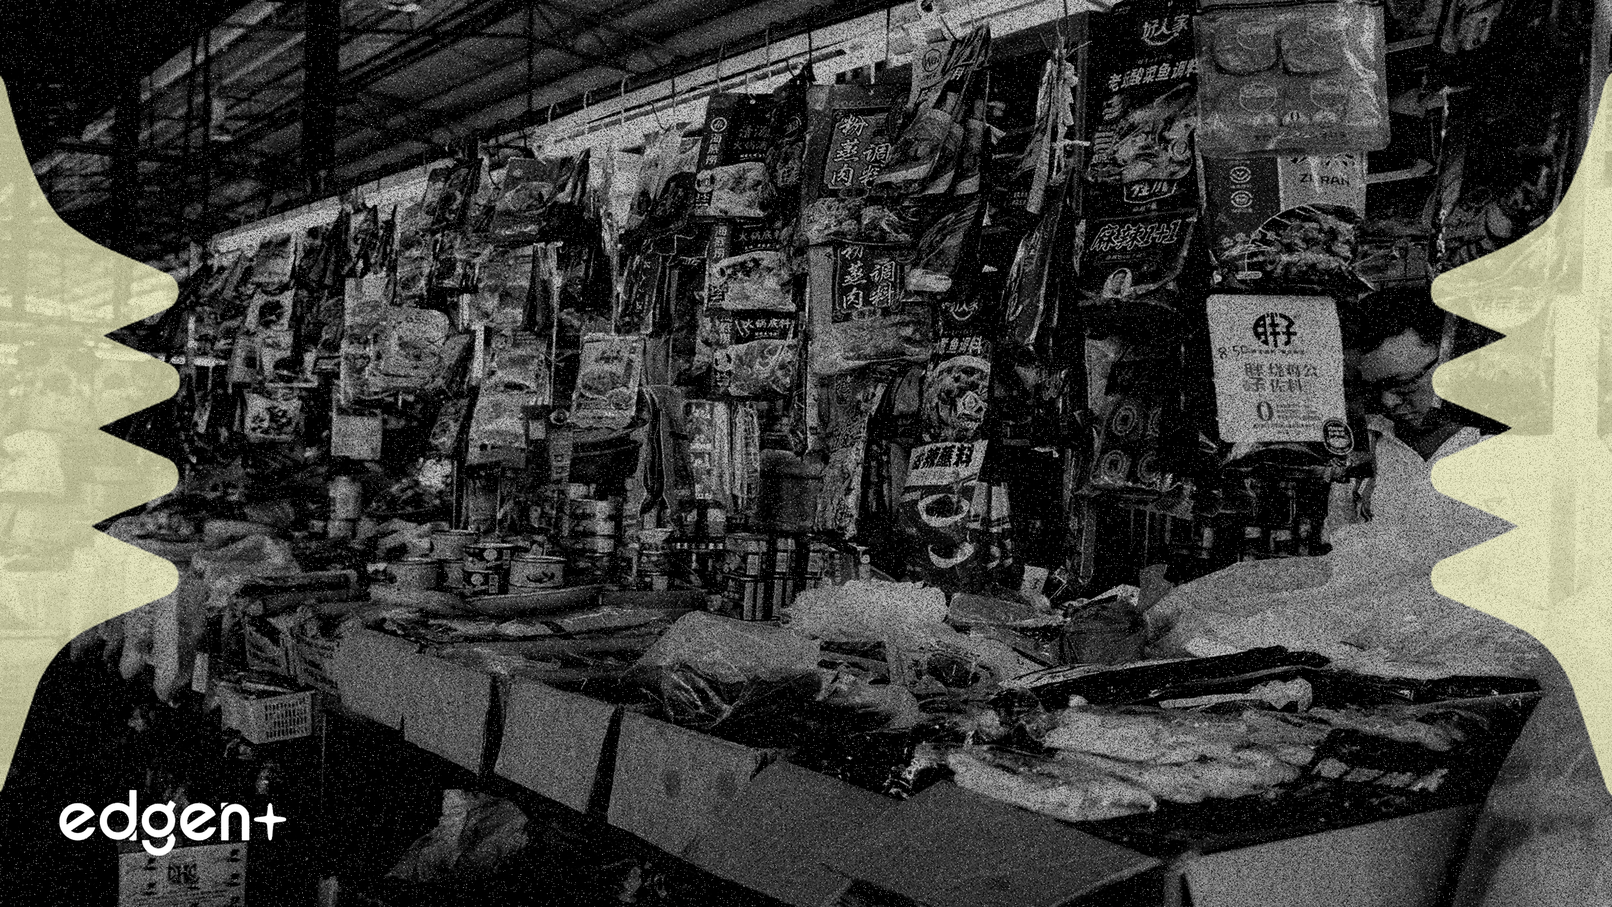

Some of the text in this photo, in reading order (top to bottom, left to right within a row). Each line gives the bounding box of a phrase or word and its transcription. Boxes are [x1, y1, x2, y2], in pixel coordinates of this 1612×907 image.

[831, 114, 869, 187] 粉蒸肉
[1090, 219, 1182, 252] 麻辣1+1
[1256, 401, 1274, 421] 0
